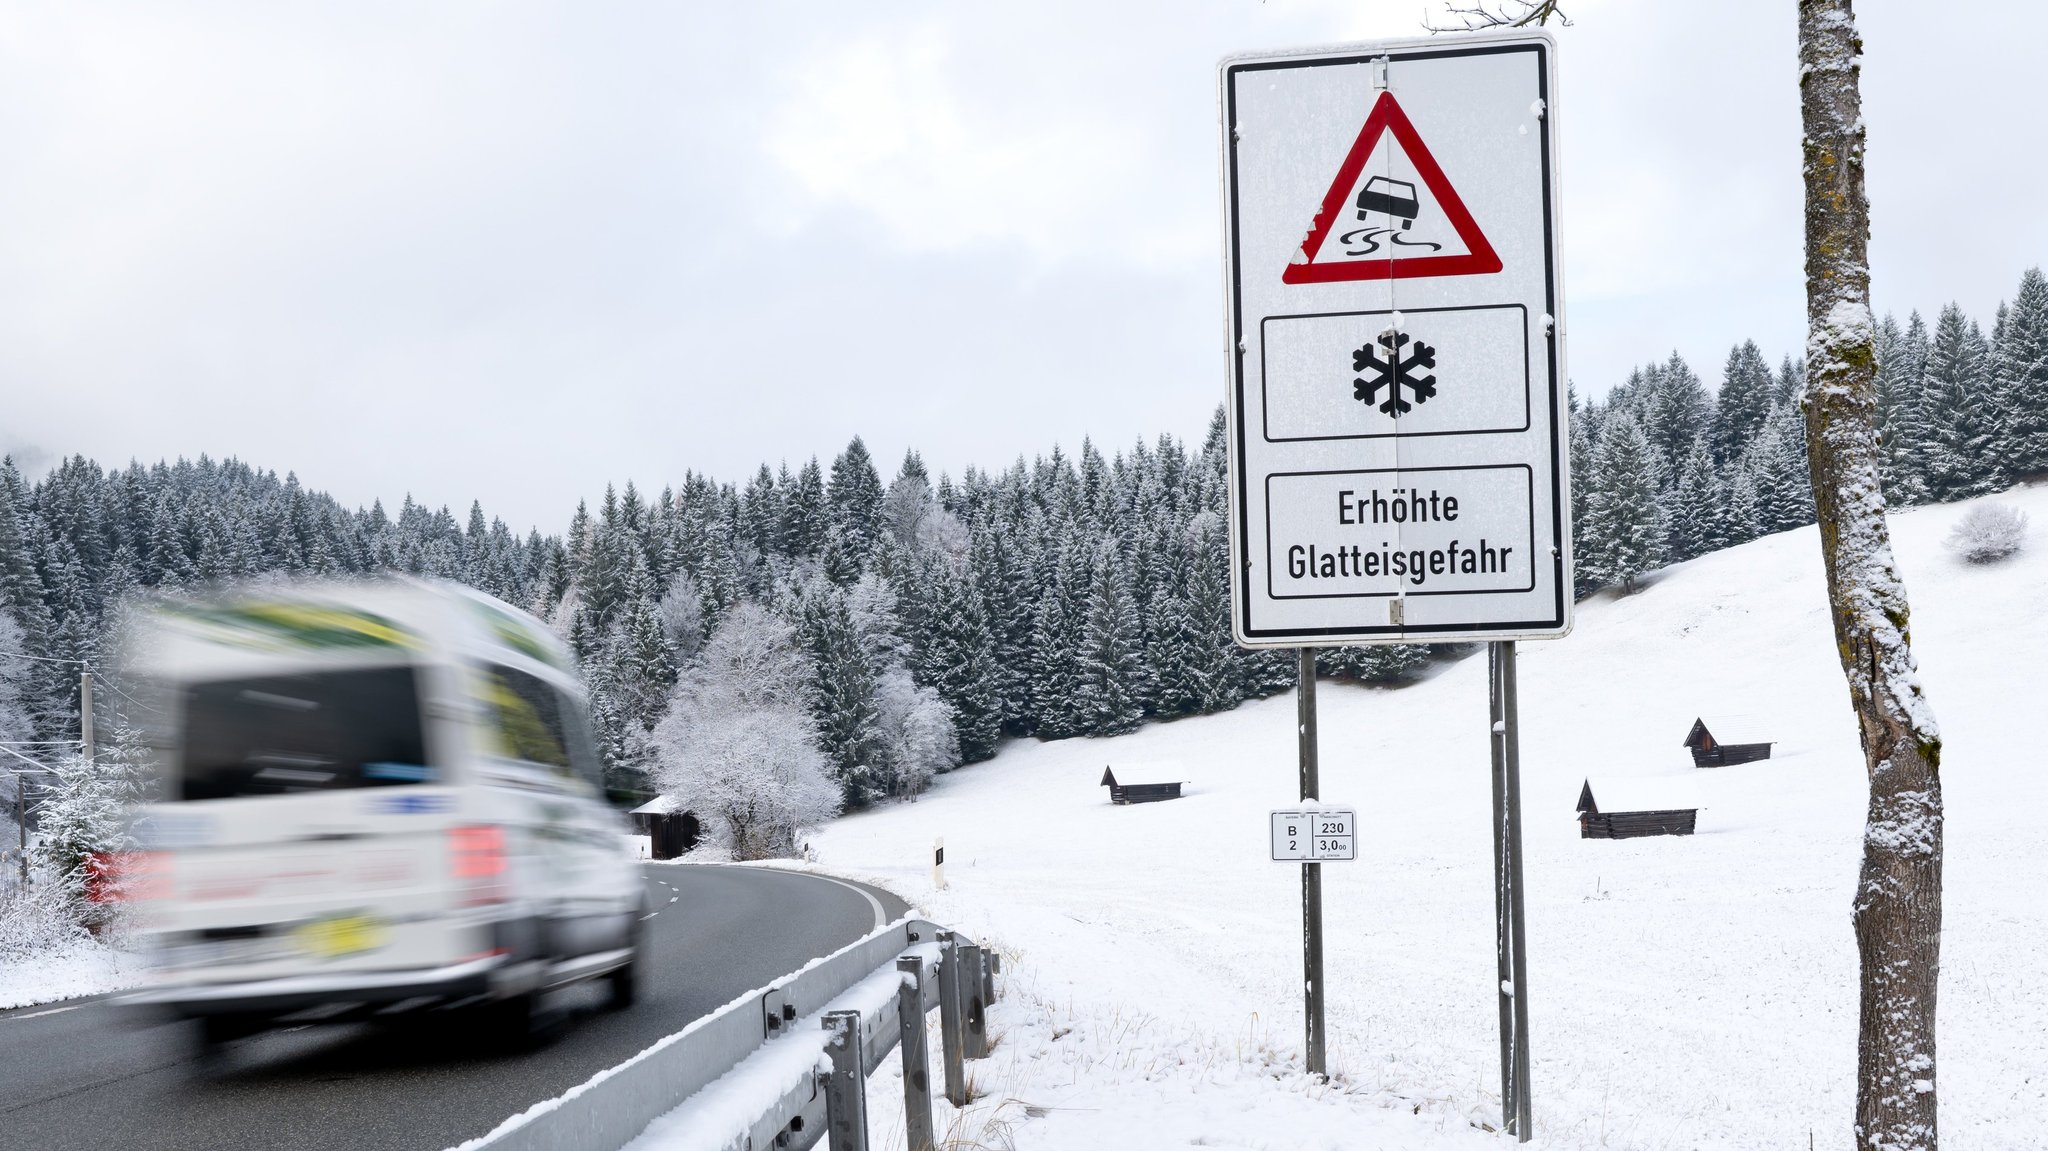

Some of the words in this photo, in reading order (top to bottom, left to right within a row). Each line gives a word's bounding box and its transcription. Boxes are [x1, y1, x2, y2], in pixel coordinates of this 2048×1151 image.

[1339, 489, 1458, 525] Erhöhte
[1288, 539, 1512, 585] Glatteisgefahr
[1288, 826, 1297, 836] B
[1322, 823, 1344, 833] 230
[1289, 840, 1297, 850] 2
